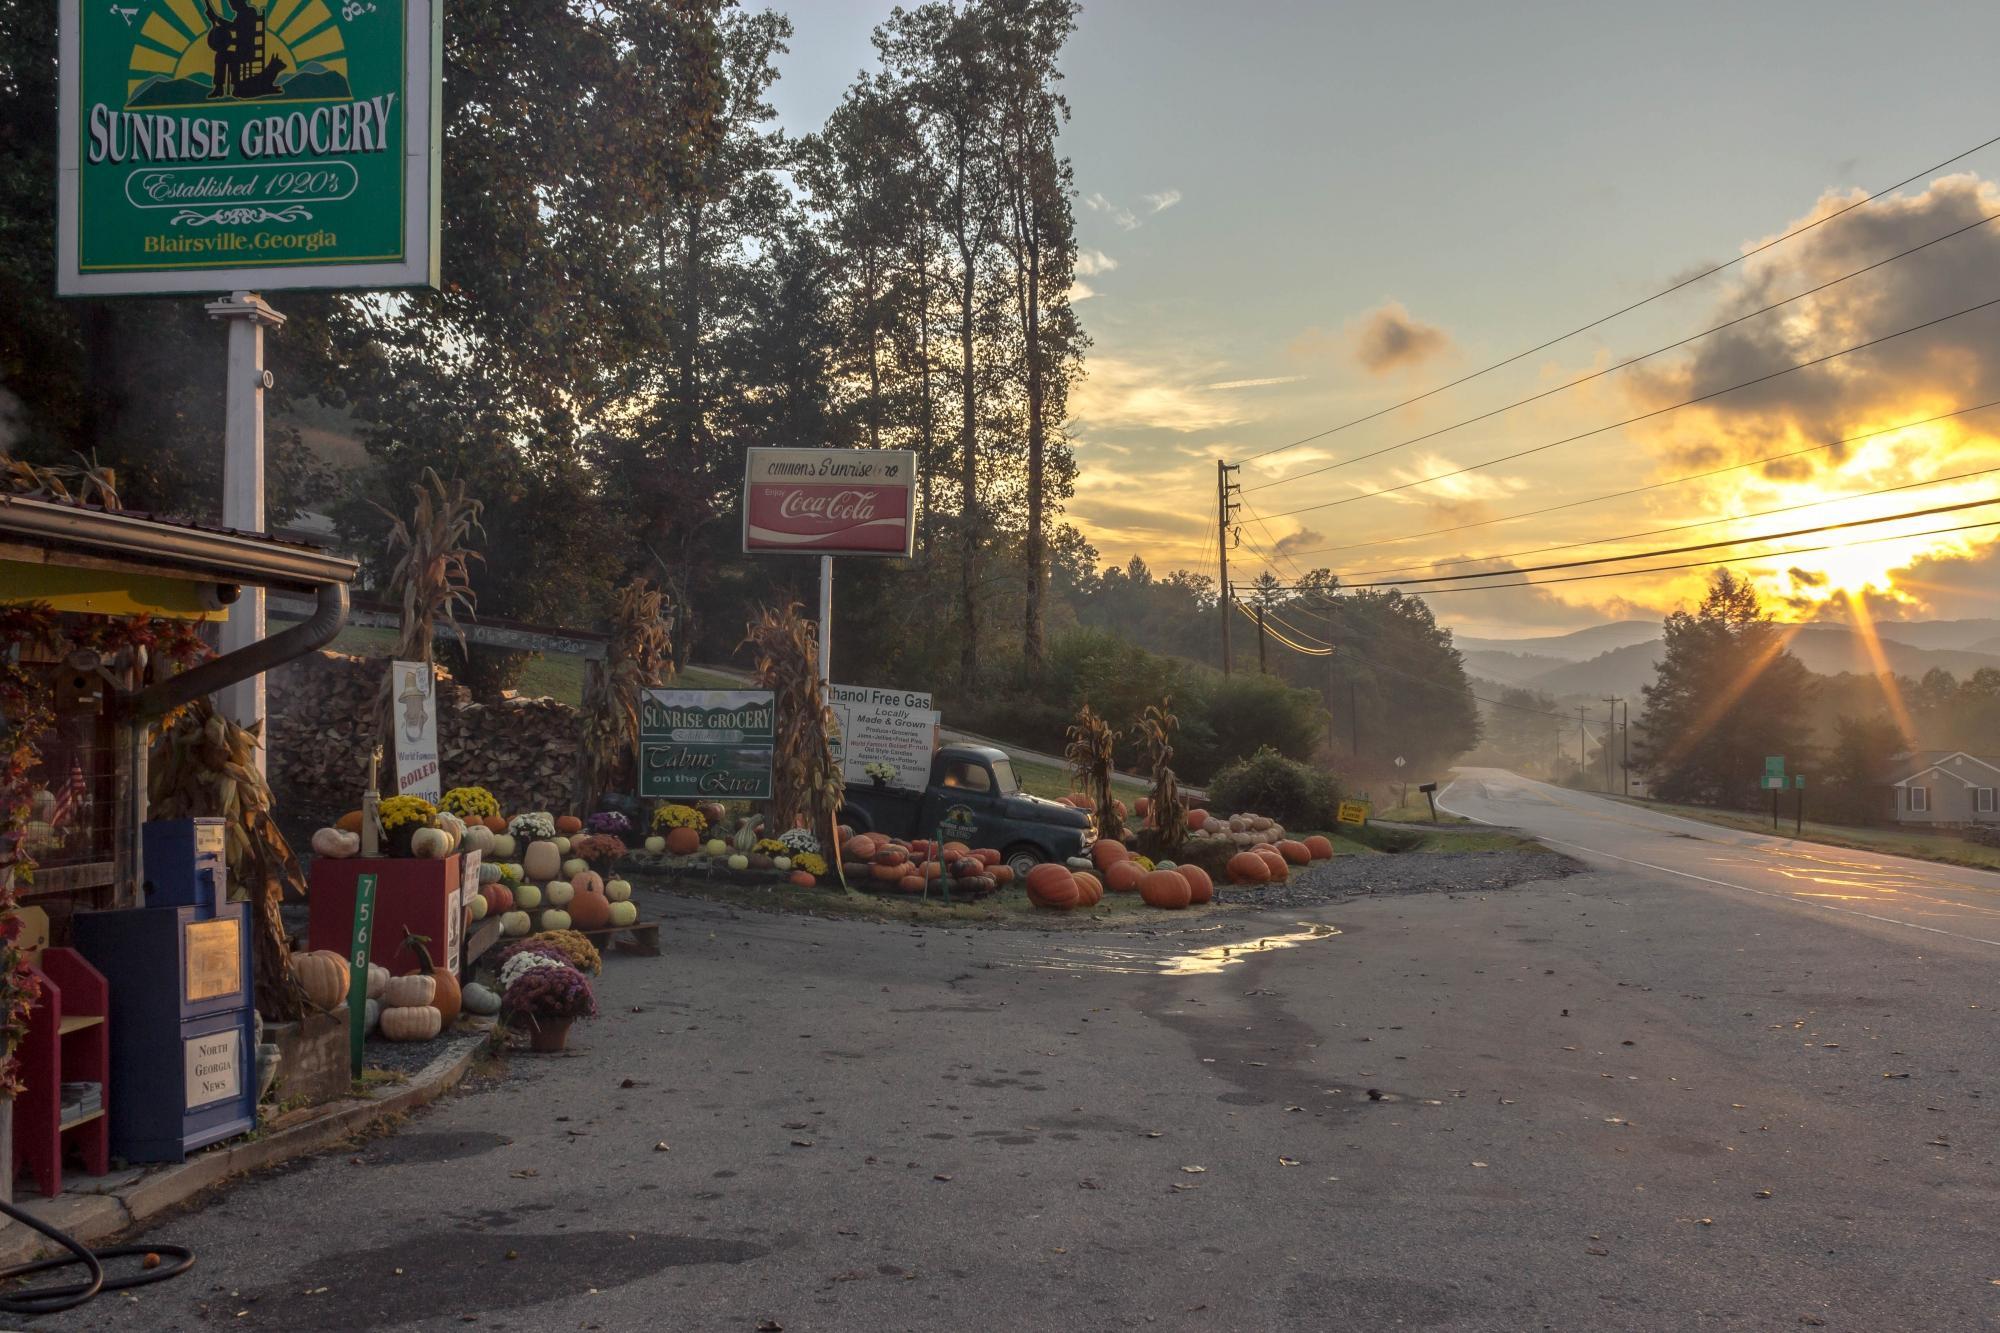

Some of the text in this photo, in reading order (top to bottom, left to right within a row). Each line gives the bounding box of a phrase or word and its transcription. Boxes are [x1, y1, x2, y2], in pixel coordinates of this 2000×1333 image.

[88, 92, 395, 164] SUNRISE GROCERY
[143, 171, 339, 201] Established 1920's
[818, 457, 872, 477] Sunrise
[764, 489, 880, 519] Enjoy Coca-Cola
[872, 690, 900, 706] Free
[904, 694, 930, 709] Gas
[643, 705, 771, 729] SUNRISE GROCERY
[857, 715, 926, 729] Made & Grown
[875, 708, 910, 719] Locally
[399, 751, 415, 761] World
[647, 745, 716, 769] Cabins
[400, 761, 437, 790] BOILED
[653, 775, 671, 783] on
[675, 774, 698, 783] the
[355, 879, 373, 968] 7568
[198, 1043, 229, 1059] NORTH
[194, 1061, 232, 1077] GEORGIA
[201, 1079, 227, 1095] NEWS
